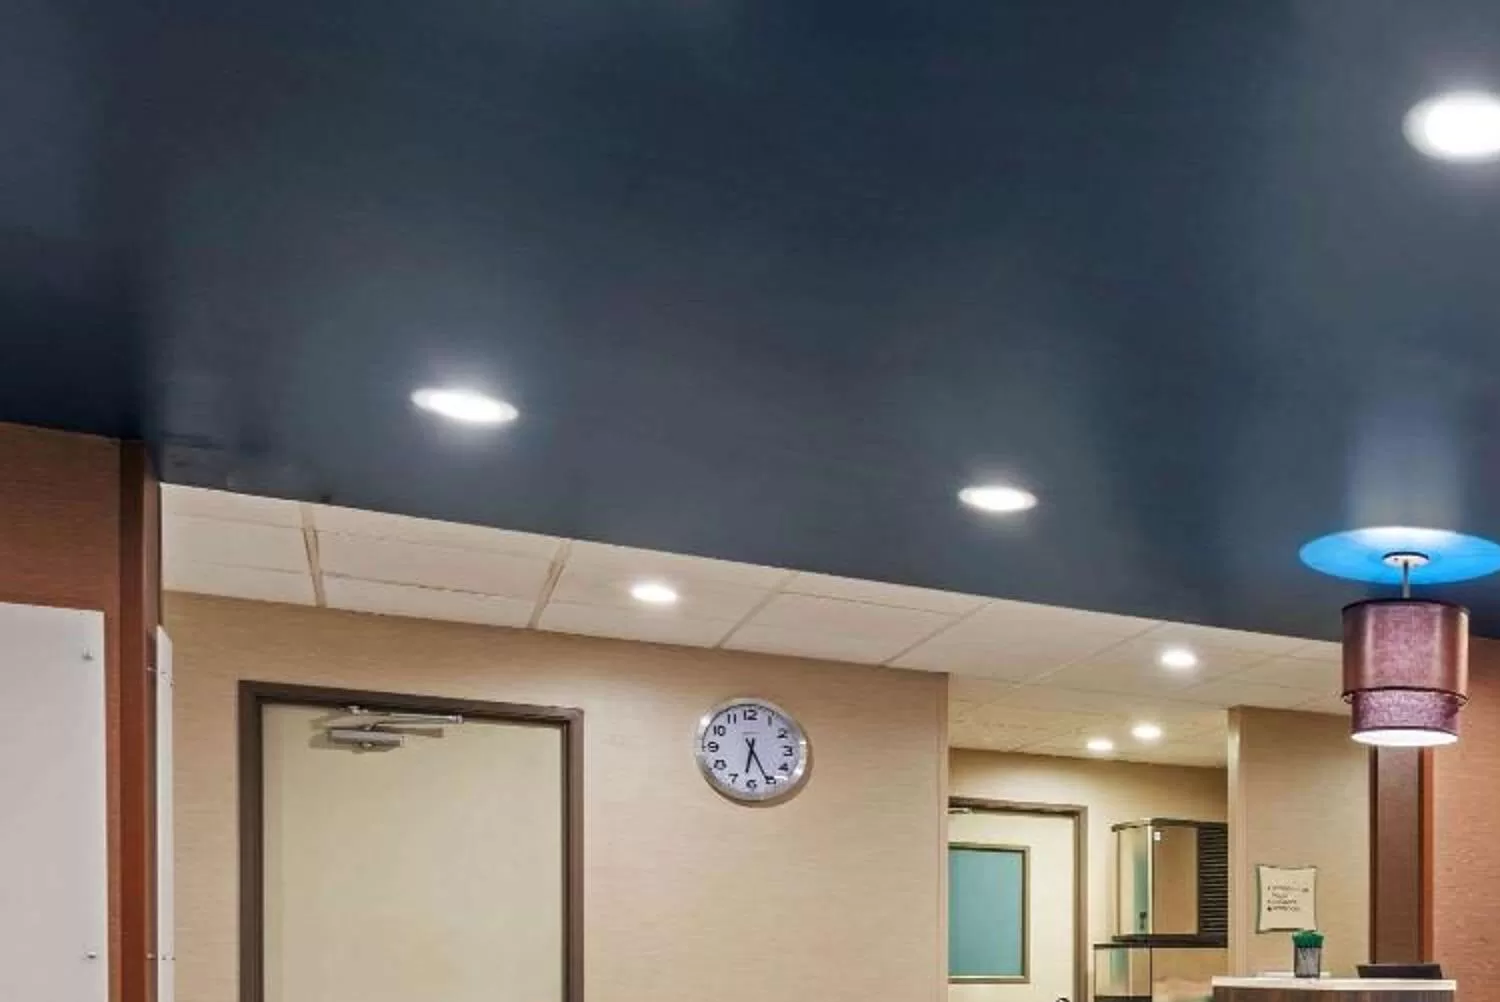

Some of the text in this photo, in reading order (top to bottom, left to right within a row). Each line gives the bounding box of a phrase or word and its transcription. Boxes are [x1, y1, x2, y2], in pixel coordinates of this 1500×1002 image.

[727, 713, 737, 724] 11
[743, 709, 758, 721] 12
[713, 725, 726, 736] 10
[776, 727, 788, 739] 2
[707, 741, 719, 752] 9
[783, 745, 794, 757] 3
[713, 759, 727, 770] 8
[778, 762, 789, 772] 4
[728, 773, 738, 784] 7
[746, 779, 758, 789] 6
